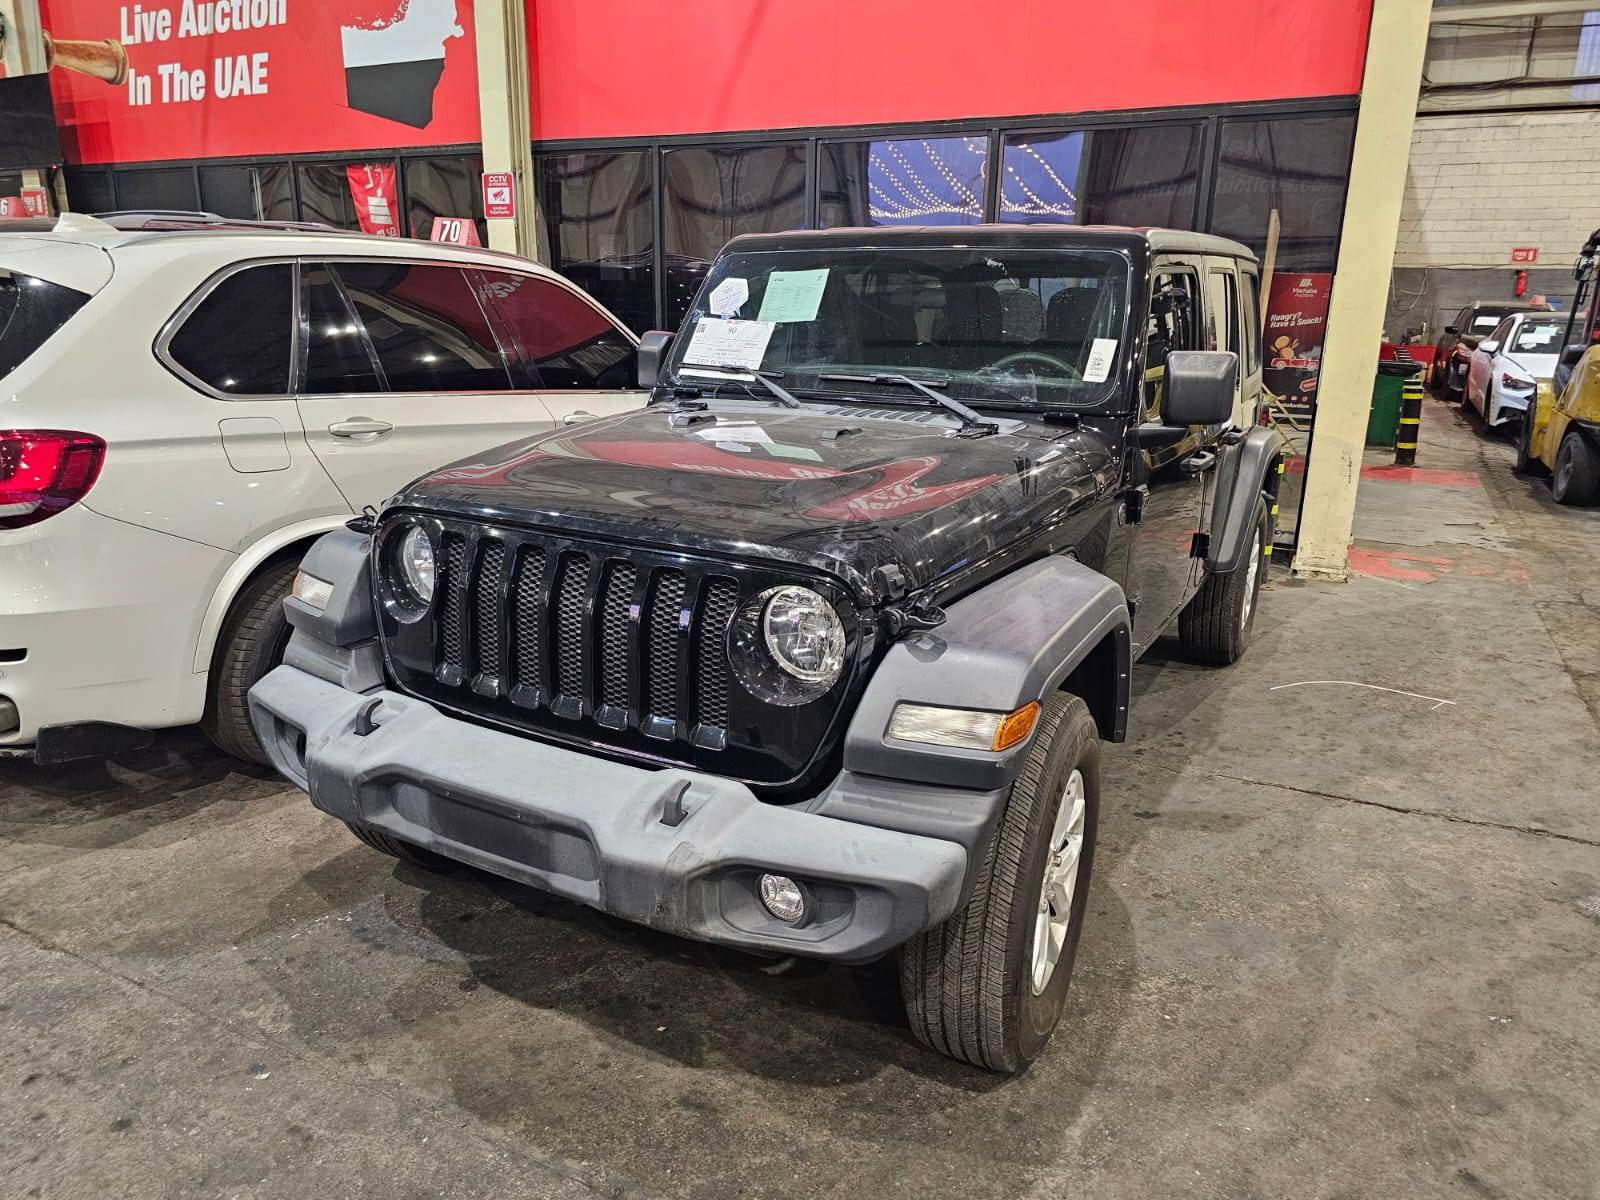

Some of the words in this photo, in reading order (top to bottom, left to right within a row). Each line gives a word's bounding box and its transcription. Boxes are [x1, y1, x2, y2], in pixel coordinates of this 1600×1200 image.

[120, 4, 172, 46] Live
[178, 0, 287, 38] Auction
[128, 68, 152, 106] In
[158, 63, 206, 103] The
[214, 52, 269, 99] UAE
[488, 175, 507, 183] CCTV
[440, 220, 461, 242] 70
[1270, 312, 1302, 322] Hungry?
[1297, 316, 1322, 326] Snack!
